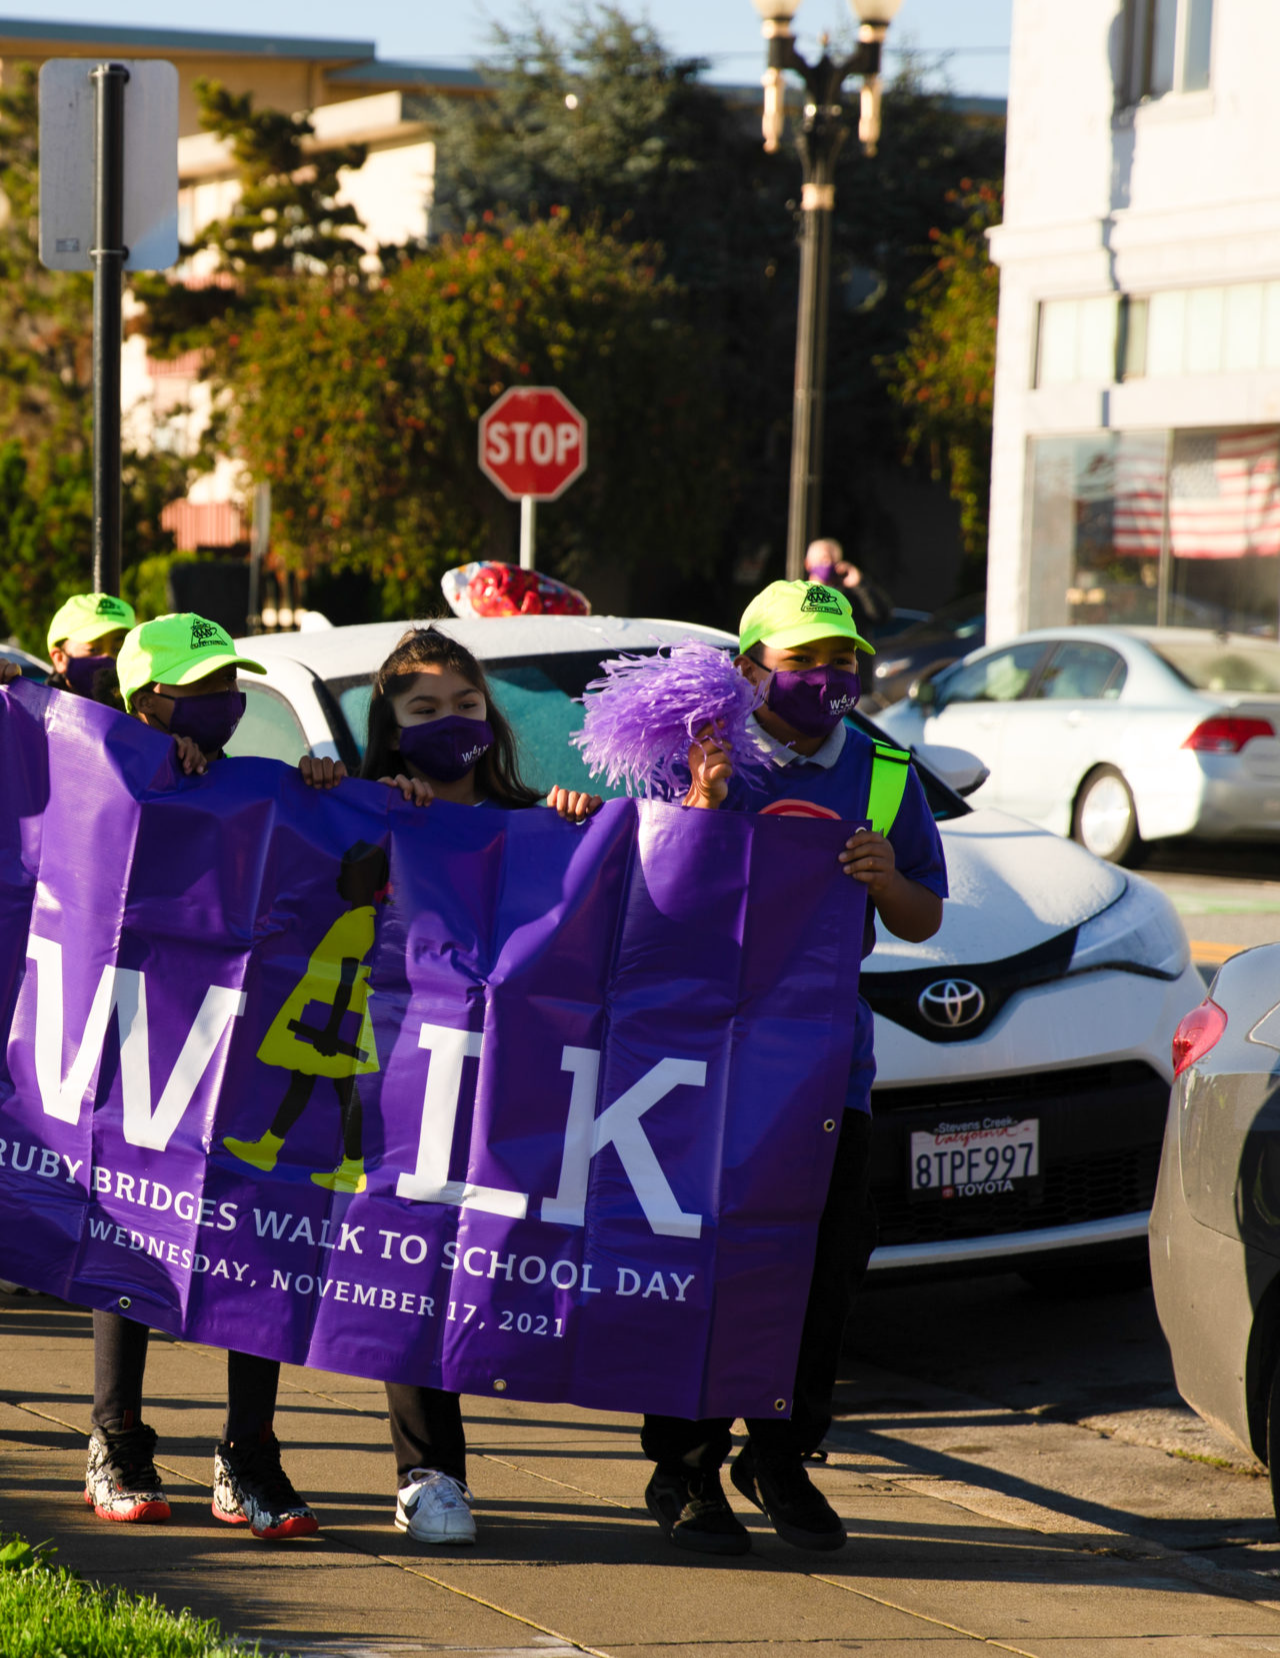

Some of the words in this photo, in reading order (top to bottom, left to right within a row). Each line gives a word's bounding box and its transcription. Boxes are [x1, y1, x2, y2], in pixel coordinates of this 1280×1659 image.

[487, 422, 579, 465] STOP
[830, 694, 856, 710] WLK
[26, 932, 707, 1240] WLK
[938, 1121, 980, 1134] Stevens
[982, 1115, 1013, 1129] Creek
[956, 1180, 1014, 1198] TOYOTA
[91, 1165, 238, 1231] BRIDGES
[253, 1208, 365, 1254] WALK
[378, 1229, 428, 1264] TO
[441, 1241, 601, 1293] SCHOOL
[615, 1267, 695, 1301] DAY
[88, 1218, 257, 1287] WEDNESDAY,
[270, 1269, 435, 1317] NOVEMBER
[447, 1301, 486, 1330] 17,
[498, 1310, 563, 1338] 2021
